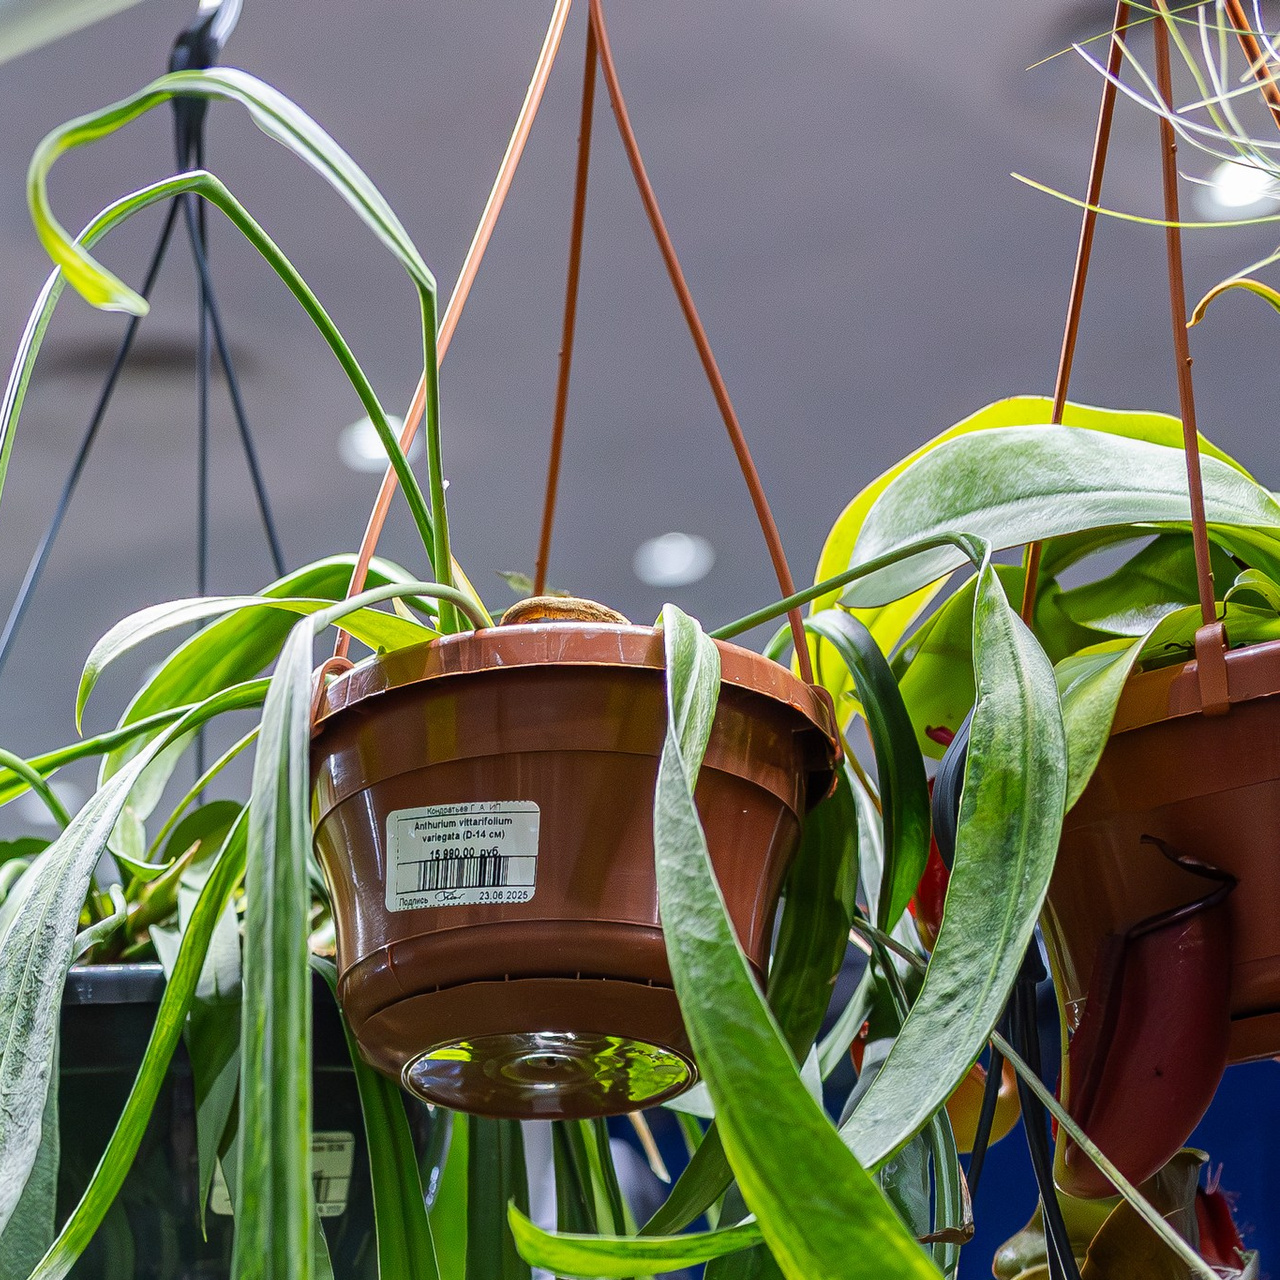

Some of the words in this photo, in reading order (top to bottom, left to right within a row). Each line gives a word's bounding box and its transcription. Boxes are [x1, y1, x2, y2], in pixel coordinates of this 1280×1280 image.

[414, 819, 457, 831] Anthurium
[459, 816, 513, 827] vittarifolium
[422, 832, 460, 843] variegata
[463, 830, 486, 841] (D-14
[399, 896, 429, 907] Подпись
[479, 890, 529, 901] 23.06.2025
